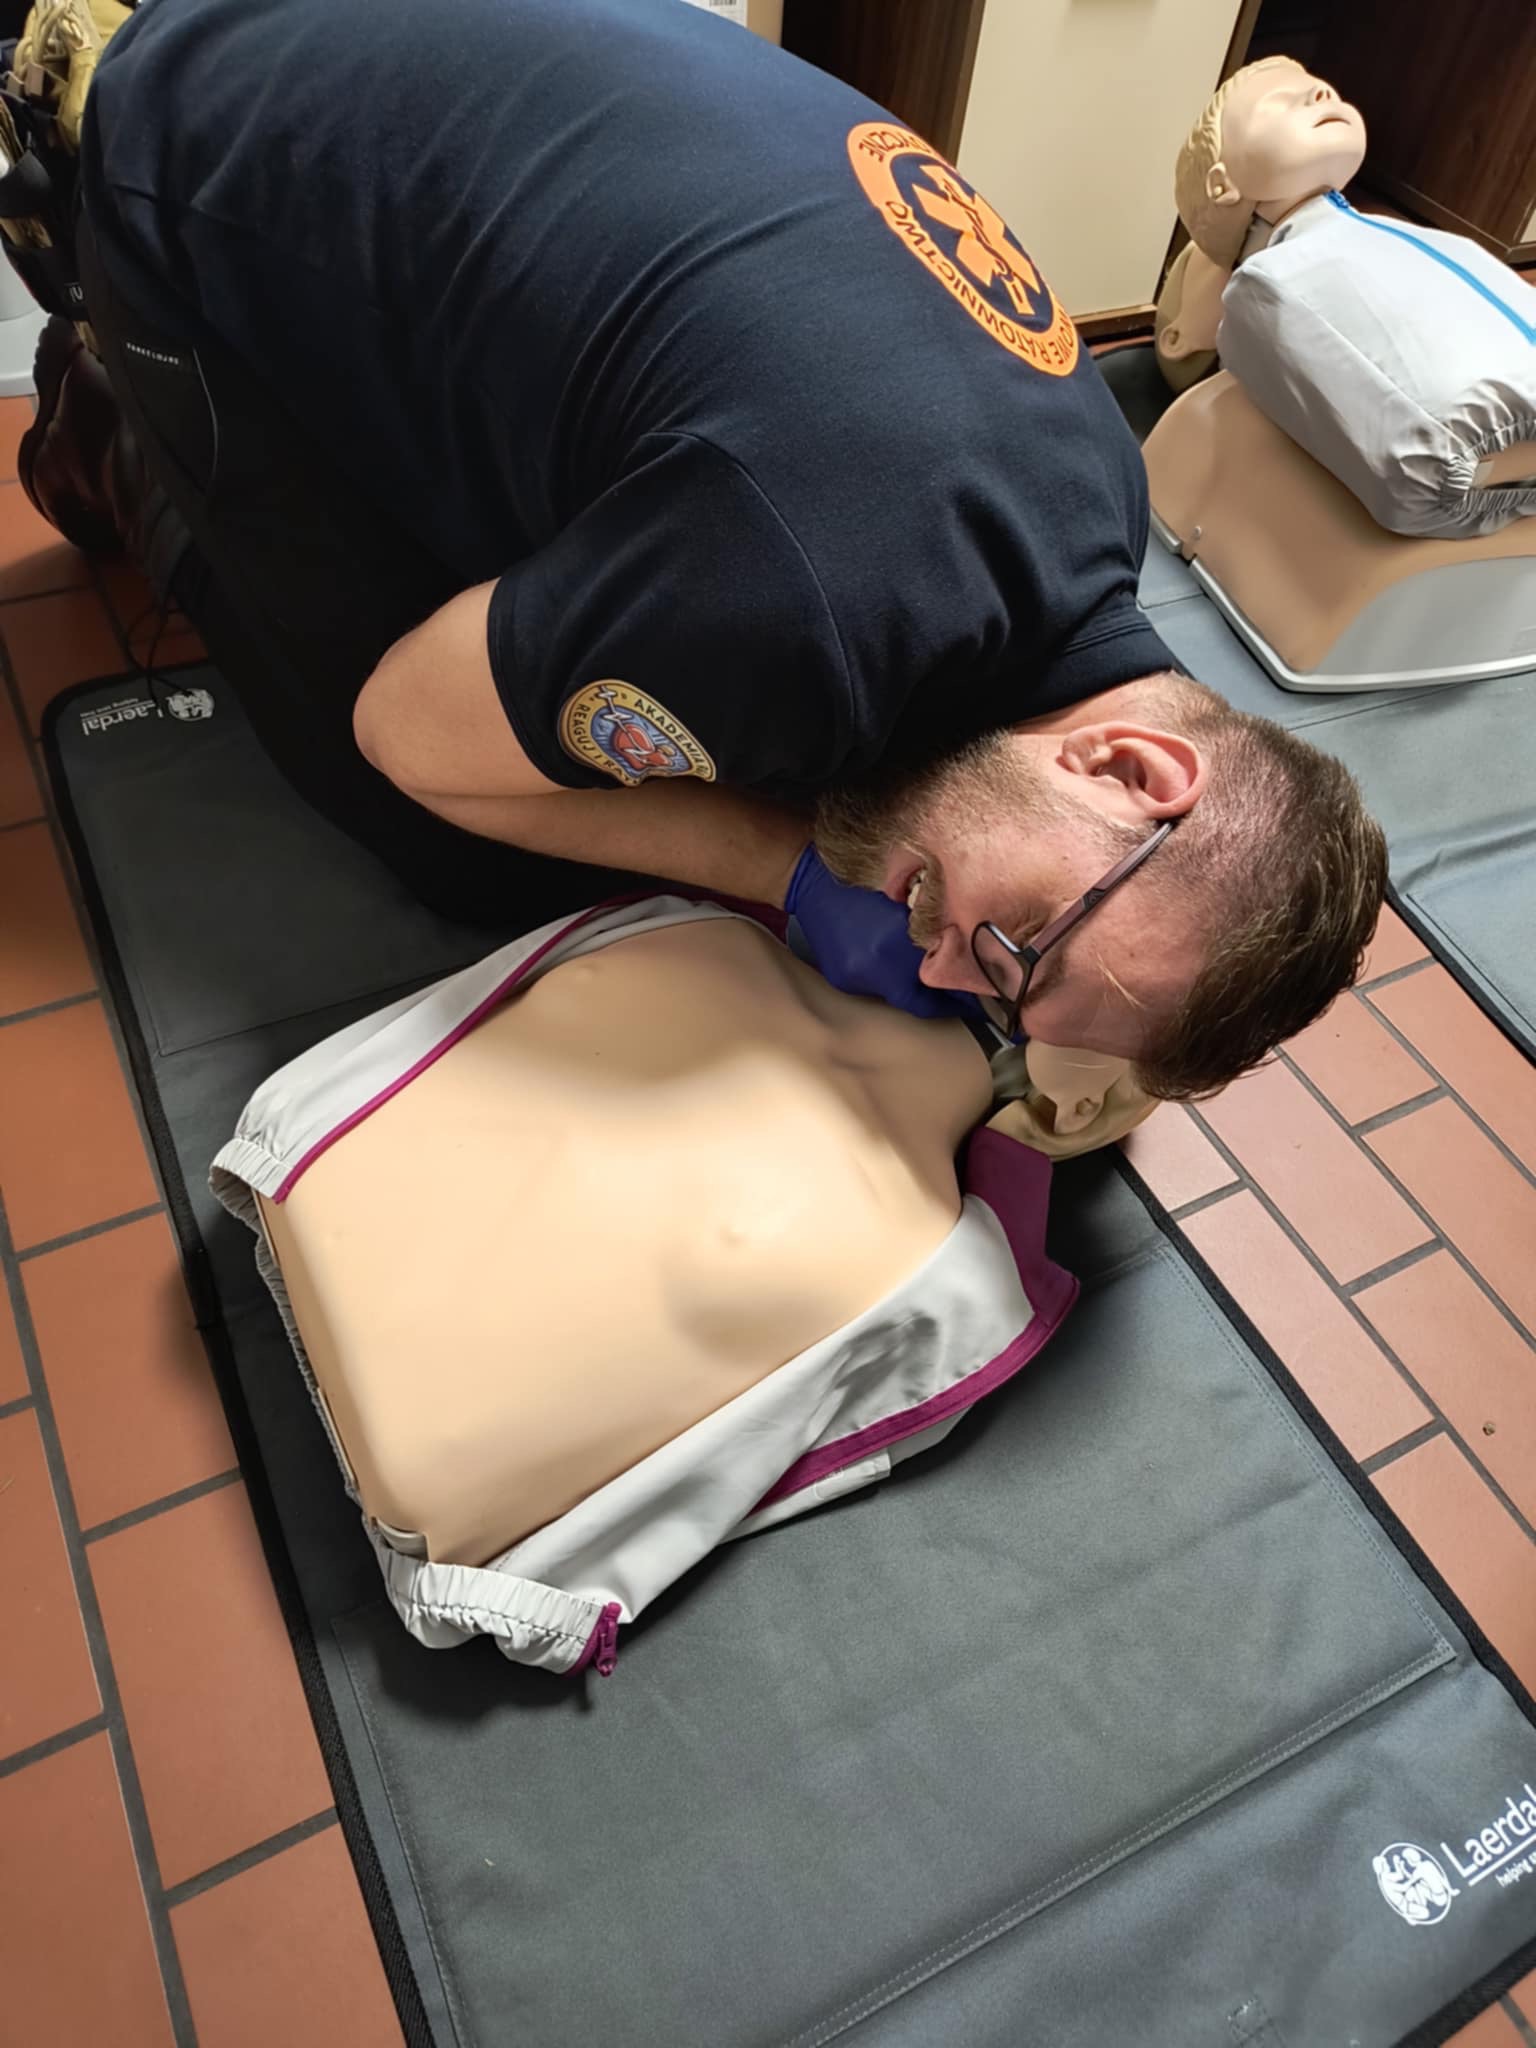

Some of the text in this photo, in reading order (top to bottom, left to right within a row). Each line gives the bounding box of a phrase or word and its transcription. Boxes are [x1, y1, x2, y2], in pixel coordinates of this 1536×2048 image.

[886, 201, 1053, 365] RATOWNICTWO
[573, 703, 594, 752] REAGUJ
[634, 698, 705, 763] AKADEMIA
